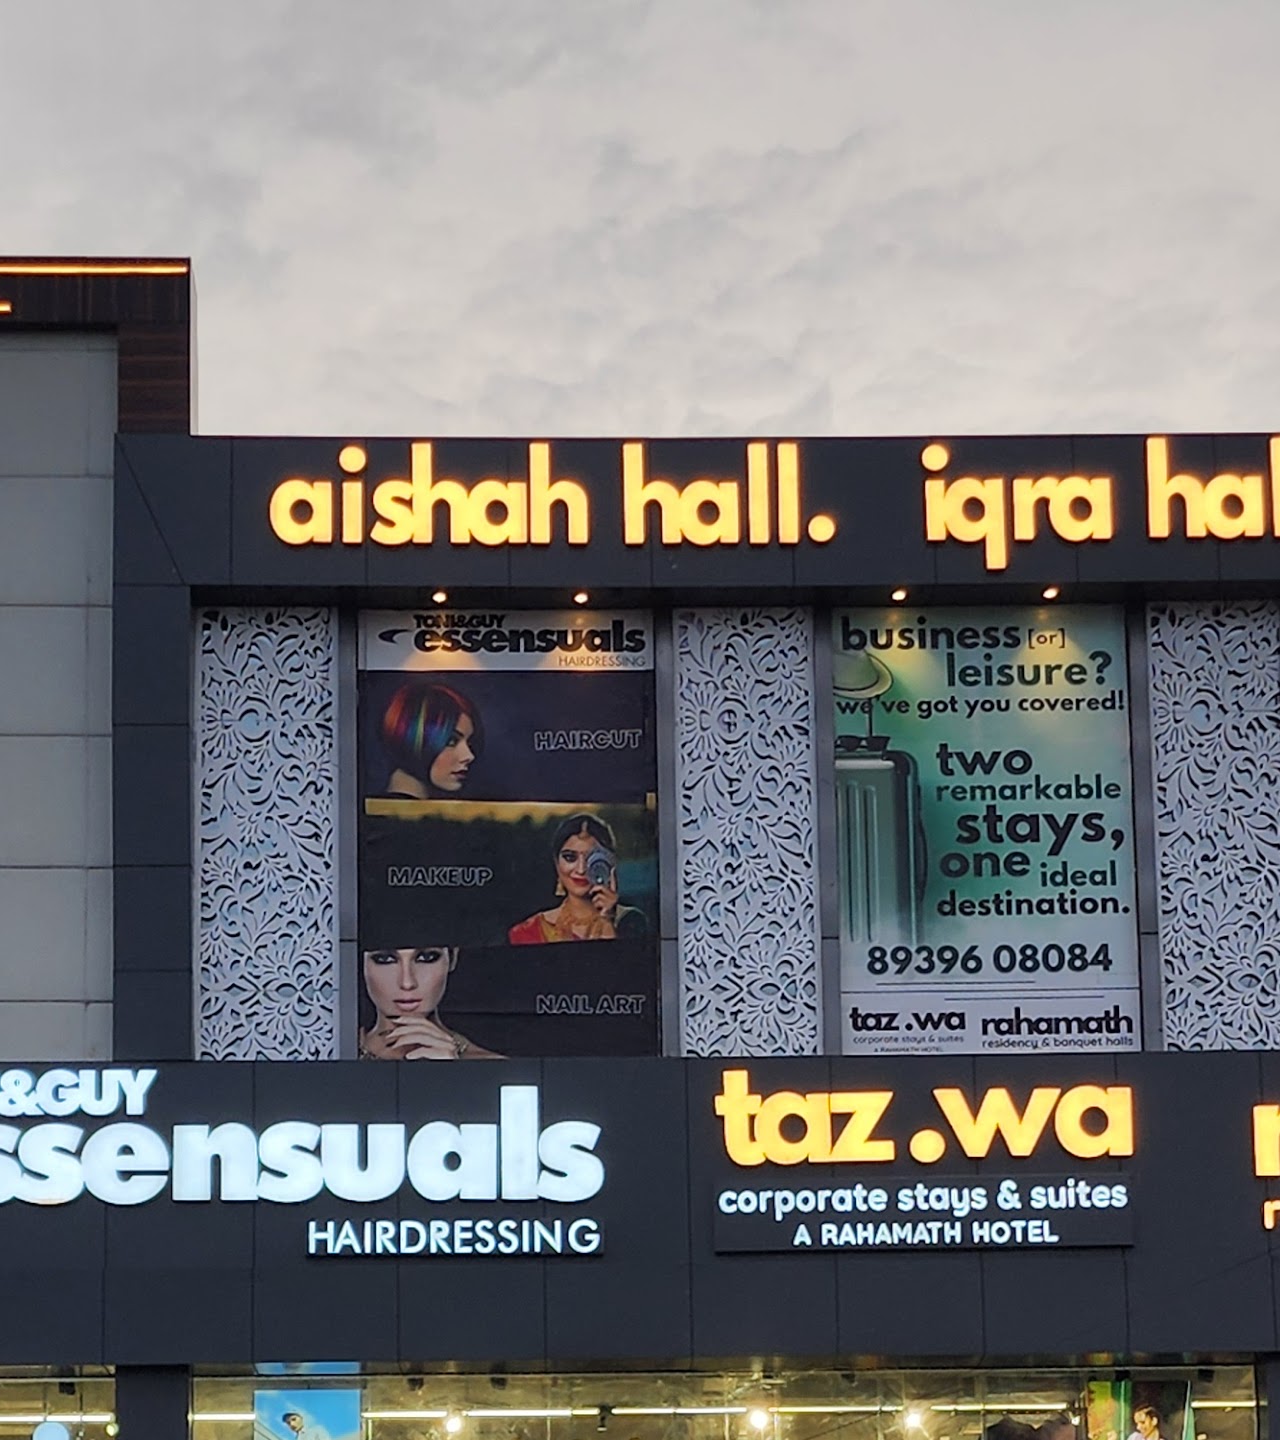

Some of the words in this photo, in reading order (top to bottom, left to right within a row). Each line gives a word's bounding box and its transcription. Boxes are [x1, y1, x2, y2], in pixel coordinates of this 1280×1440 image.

[270, 442, 588, 545] aishah
[623, 442, 836, 545] hall.
[921, 443, 1114, 571] iqra
[414, 619, 646, 654] essensuals
[842, 616, 1021, 651] business
[1028, 627, 1066, 649] [or]
[558, 655, 646, 668] HAIRDRESSING
[946, 651, 1112, 687] leisure?
[917, 694, 958, 719] got
[966, 697, 1010, 719] you
[1017, 689, 1124, 713] covered!
[534, 729, 643, 751] HAIRCUT
[936, 742, 1033, 776] two
[936, 774, 1121, 801] remarkable
[956, 804, 1124, 856] stays,
[388, 865, 493, 887] MAKEUP
[939, 851, 1030, 879] one
[1040, 861, 1117, 887] ideal
[937, 888, 1130, 917] destination.
[867, 945, 983, 976] 89396
[993, 943, 1112, 974] 08084
[536, 995, 592, 1014] NAIL
[596, 994, 646, 1014] ART
[982, 1005, 1133, 1036] rahamath
[853, 1035, 899, 1046] corporate
[937, 1034, 964, 1044] suites
[982, 1038, 1037, 1051] residency
[1041, 1038, 1050, 1047] &
[1054, 1037, 1108, 1051] banquet
[1111, 1035, 1133, 1047] halls
[718, 1182, 888, 1222] corporate
[897, 1182, 988, 1218] stays
[997, 1178, 1023, 1210] &
[1029, 1176, 1129, 1210] suites
[307, 1218, 602, 1257] HAIRDRESSING
[793, 1222, 813, 1246] A
[821, 1221, 961, 1246] RAHAMATH
[972, 1219, 1059, 1245] HOTEL
